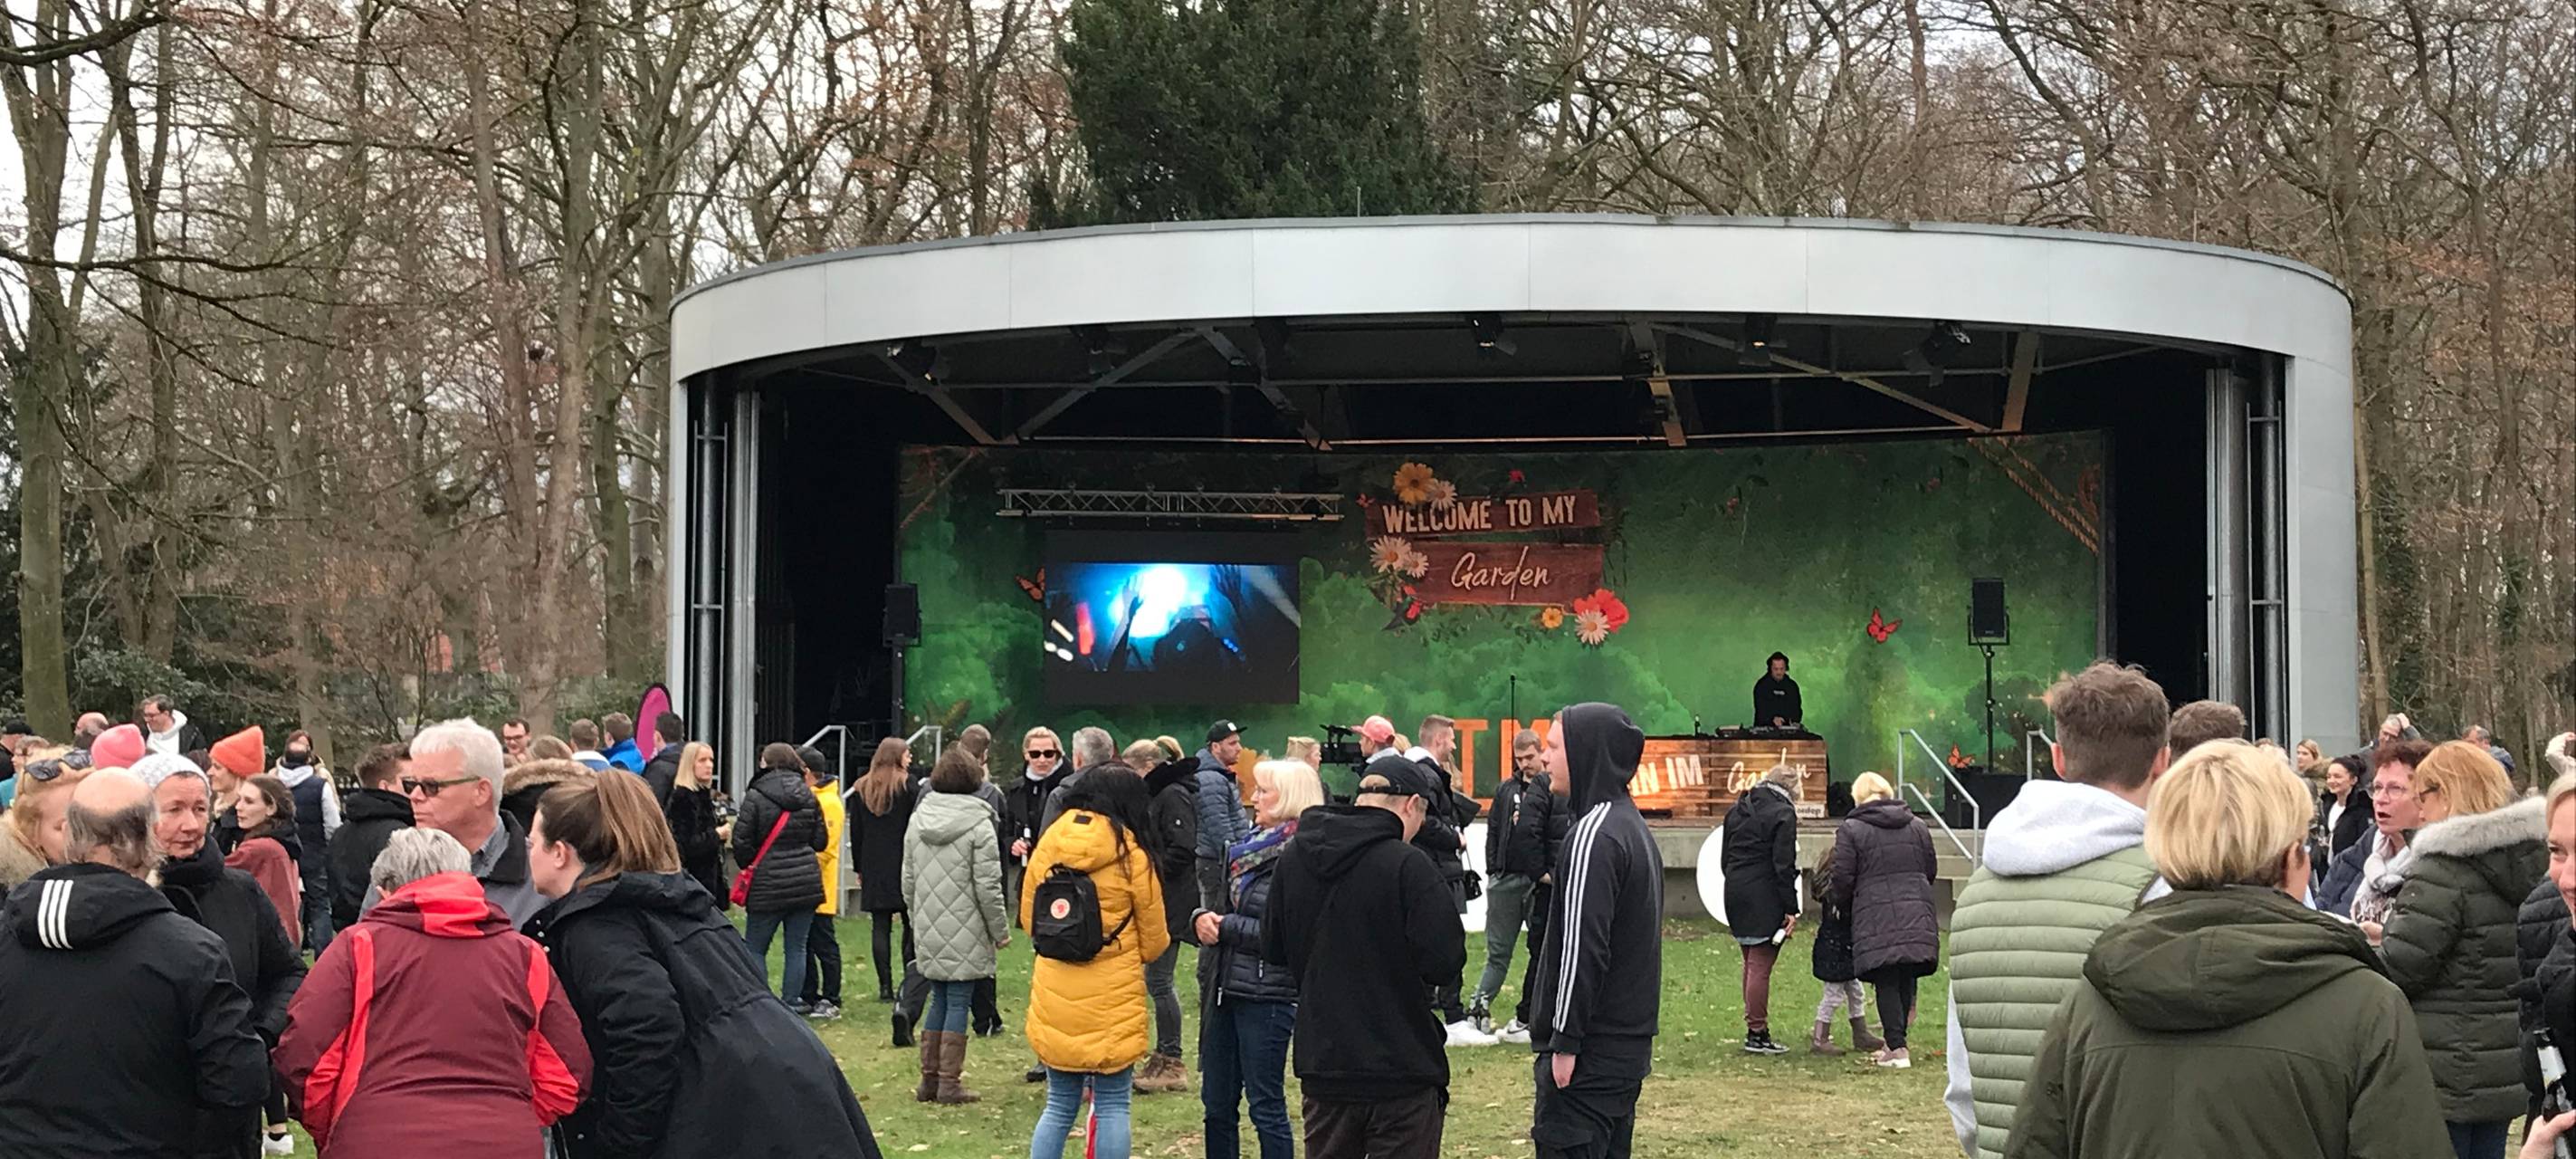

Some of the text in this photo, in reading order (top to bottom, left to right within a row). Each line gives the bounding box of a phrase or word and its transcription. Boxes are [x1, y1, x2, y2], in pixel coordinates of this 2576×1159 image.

[1383, 495, 1576, 532] WELCOME TO MY
[1451, 545, 1550, 600] Garden
[1665, 754, 1704, 789] IM
